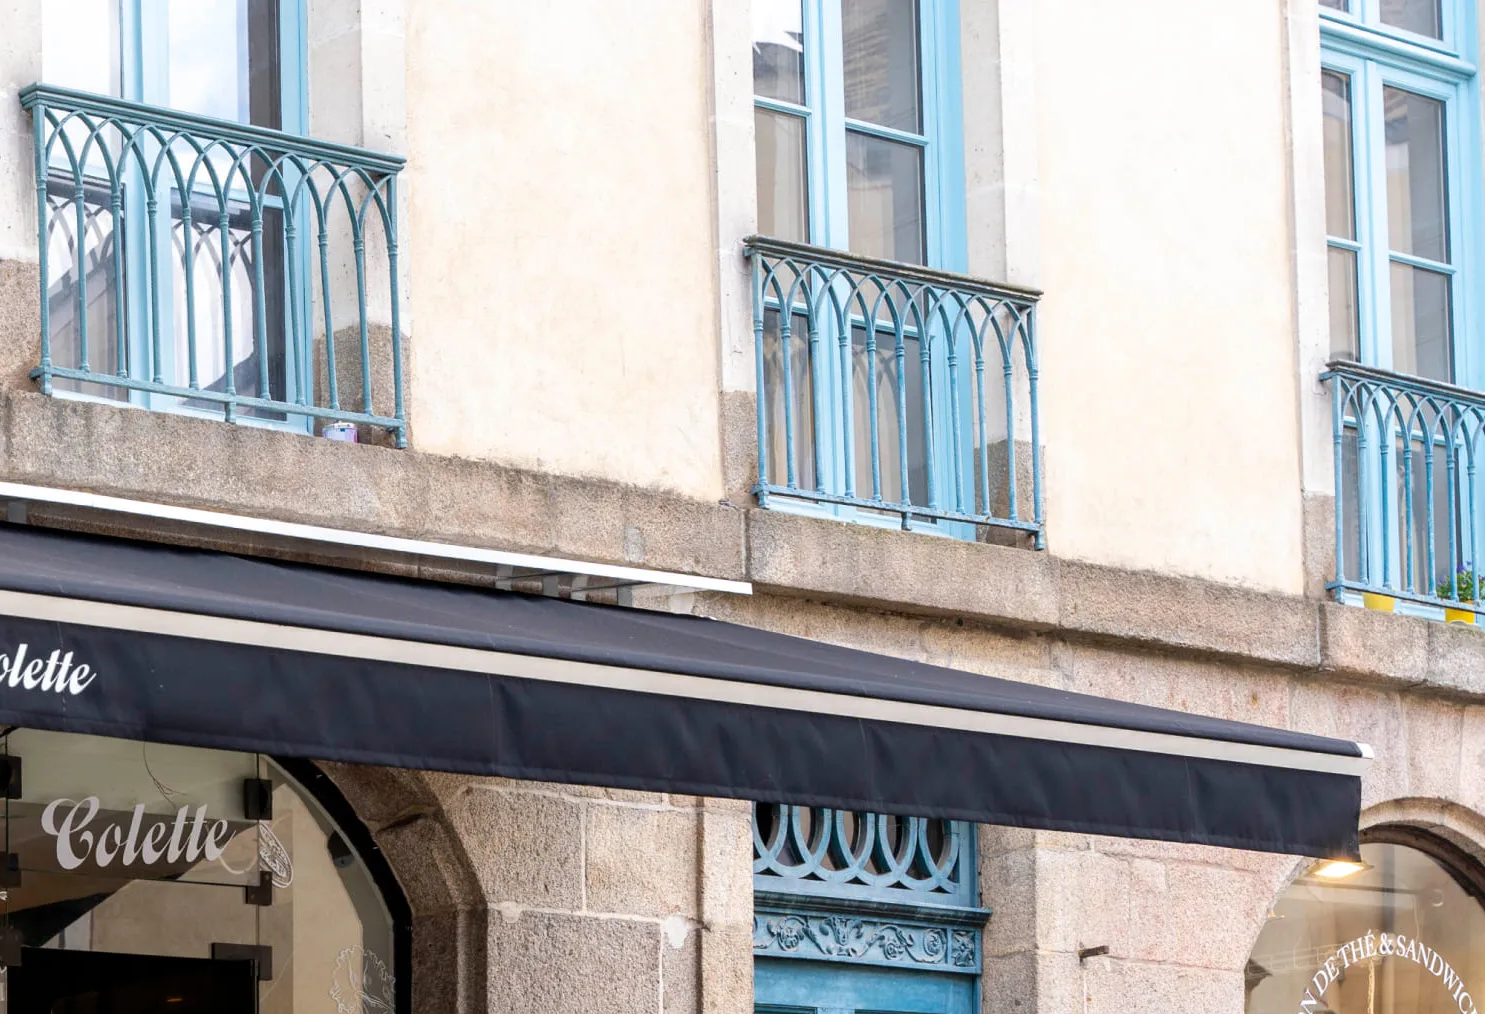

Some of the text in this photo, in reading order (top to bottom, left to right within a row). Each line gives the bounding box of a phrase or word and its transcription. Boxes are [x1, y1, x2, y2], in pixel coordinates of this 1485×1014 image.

[41, 796, 237, 871] Colette
[1312, 957, 1340, 996] DE
[1337, 929, 1377, 968] THÉ
[1379, 932, 1394, 955] &
